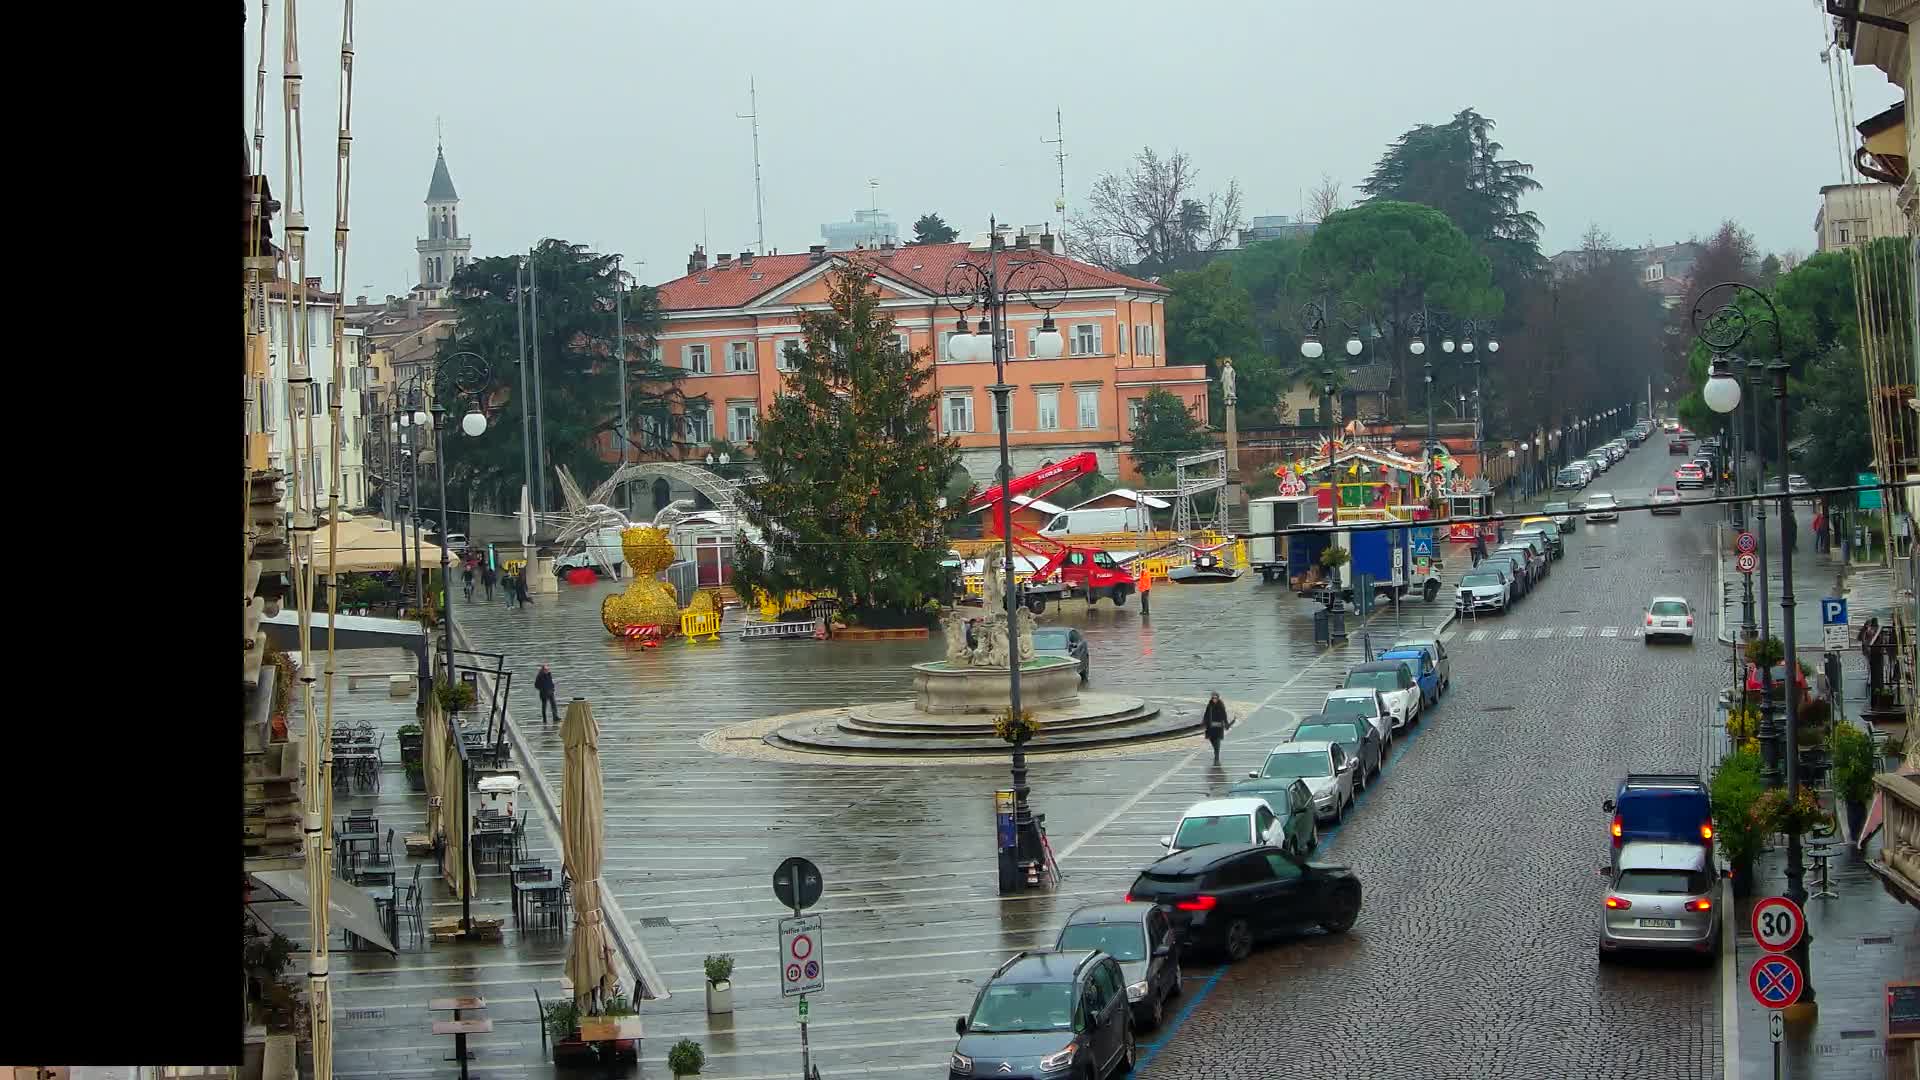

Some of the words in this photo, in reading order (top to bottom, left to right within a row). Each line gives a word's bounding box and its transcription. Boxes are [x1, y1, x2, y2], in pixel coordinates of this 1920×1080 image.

[1742, 557, 1753, 567] 20
[1827, 602, 1842, 622] P
[1762, 911, 1792, 937] 30
